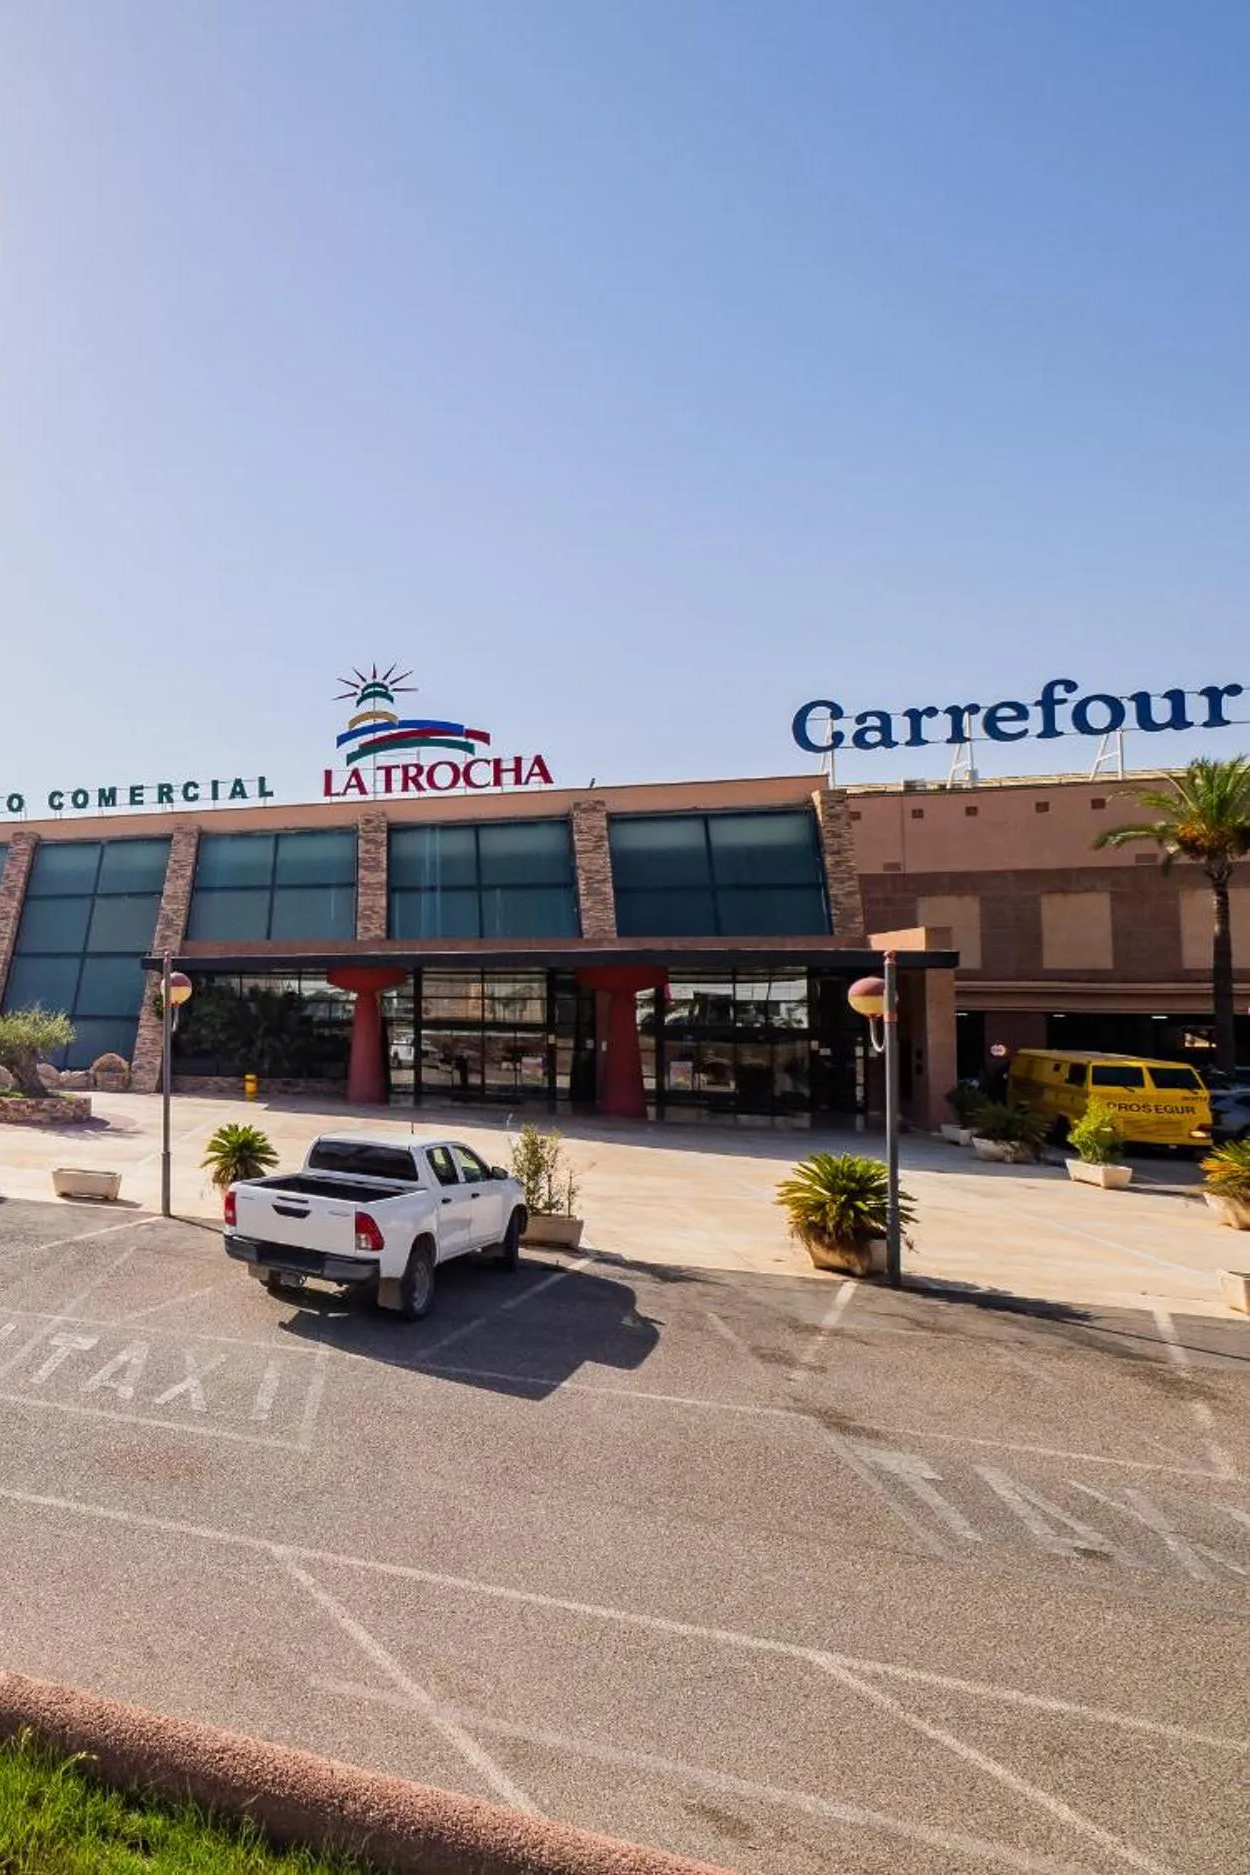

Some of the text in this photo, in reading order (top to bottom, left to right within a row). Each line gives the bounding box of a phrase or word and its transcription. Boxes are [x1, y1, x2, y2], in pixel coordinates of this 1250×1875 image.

[792, 678, 1243, 753] Carrefour
[48, 776, 274, 811] COMERCIAL
[323, 755, 554, 797] LA TROCHA
[1106, 1101, 1196, 1115] PROSEGUR
[30, 1332, 278, 1419] TAXI
